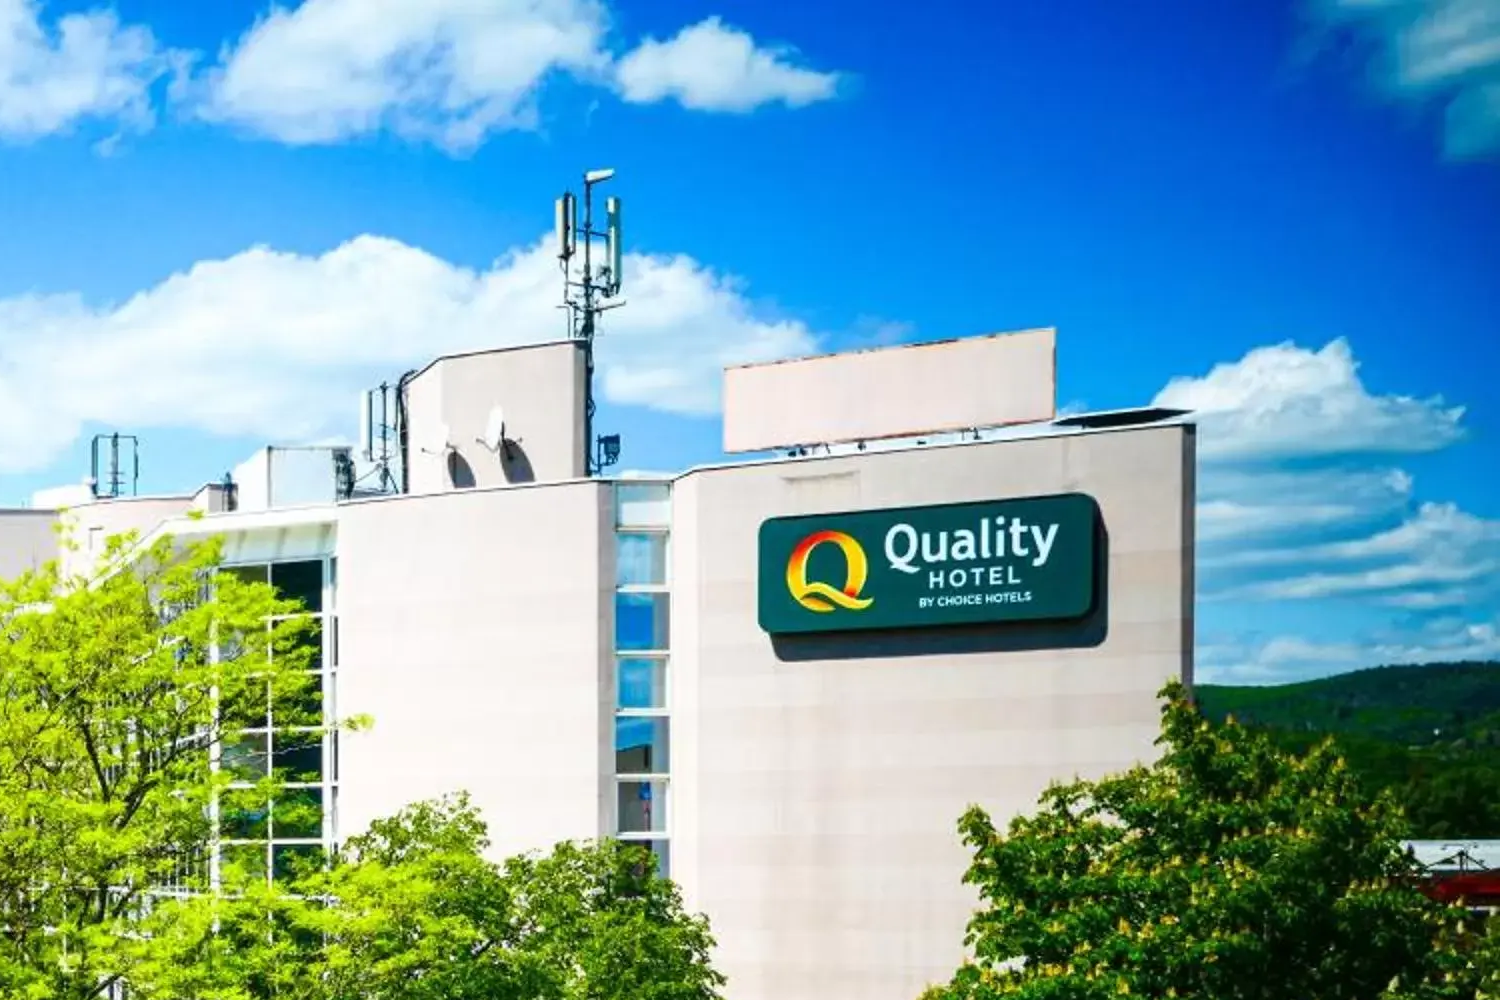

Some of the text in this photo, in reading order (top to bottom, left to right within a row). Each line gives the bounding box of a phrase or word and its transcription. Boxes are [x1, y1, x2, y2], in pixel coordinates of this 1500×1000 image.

[884, 516, 1060, 573] Quality
[929, 566, 1021, 589] HOTEL
[919, 591, 1032, 608] BY CHOICE HOTELS
